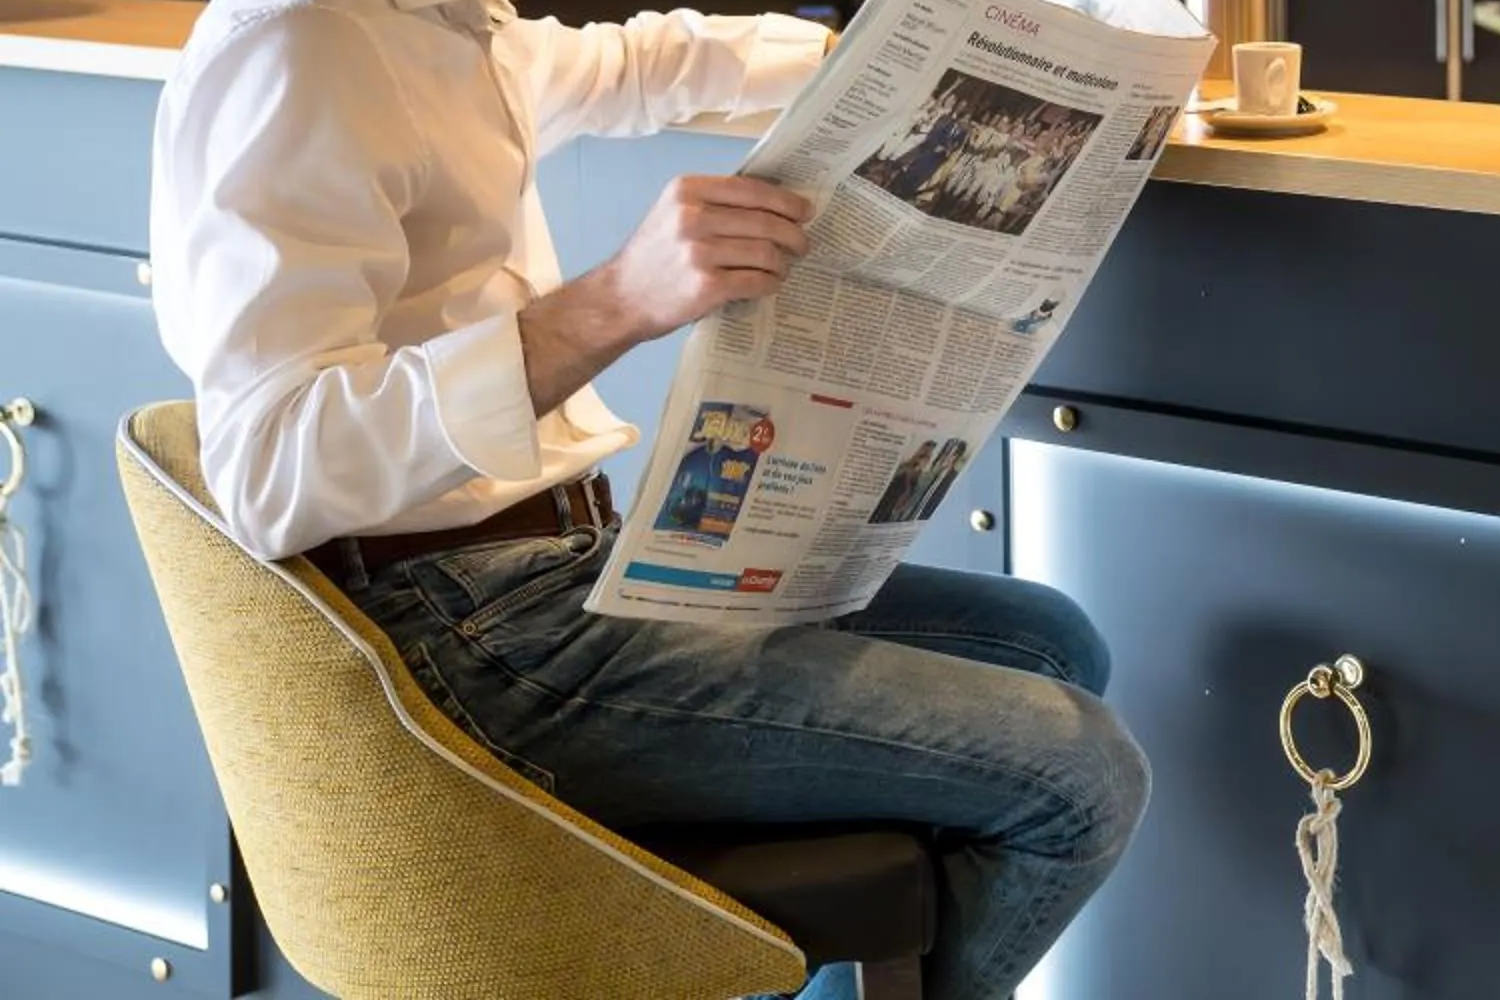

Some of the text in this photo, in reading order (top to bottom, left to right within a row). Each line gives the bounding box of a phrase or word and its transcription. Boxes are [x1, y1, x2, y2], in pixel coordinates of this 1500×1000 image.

[985, 4, 1041, 36] CINÉMA
[967, 30, 1053, 73] Révolutionnaire
[1052, 64, 1069, 79] et
